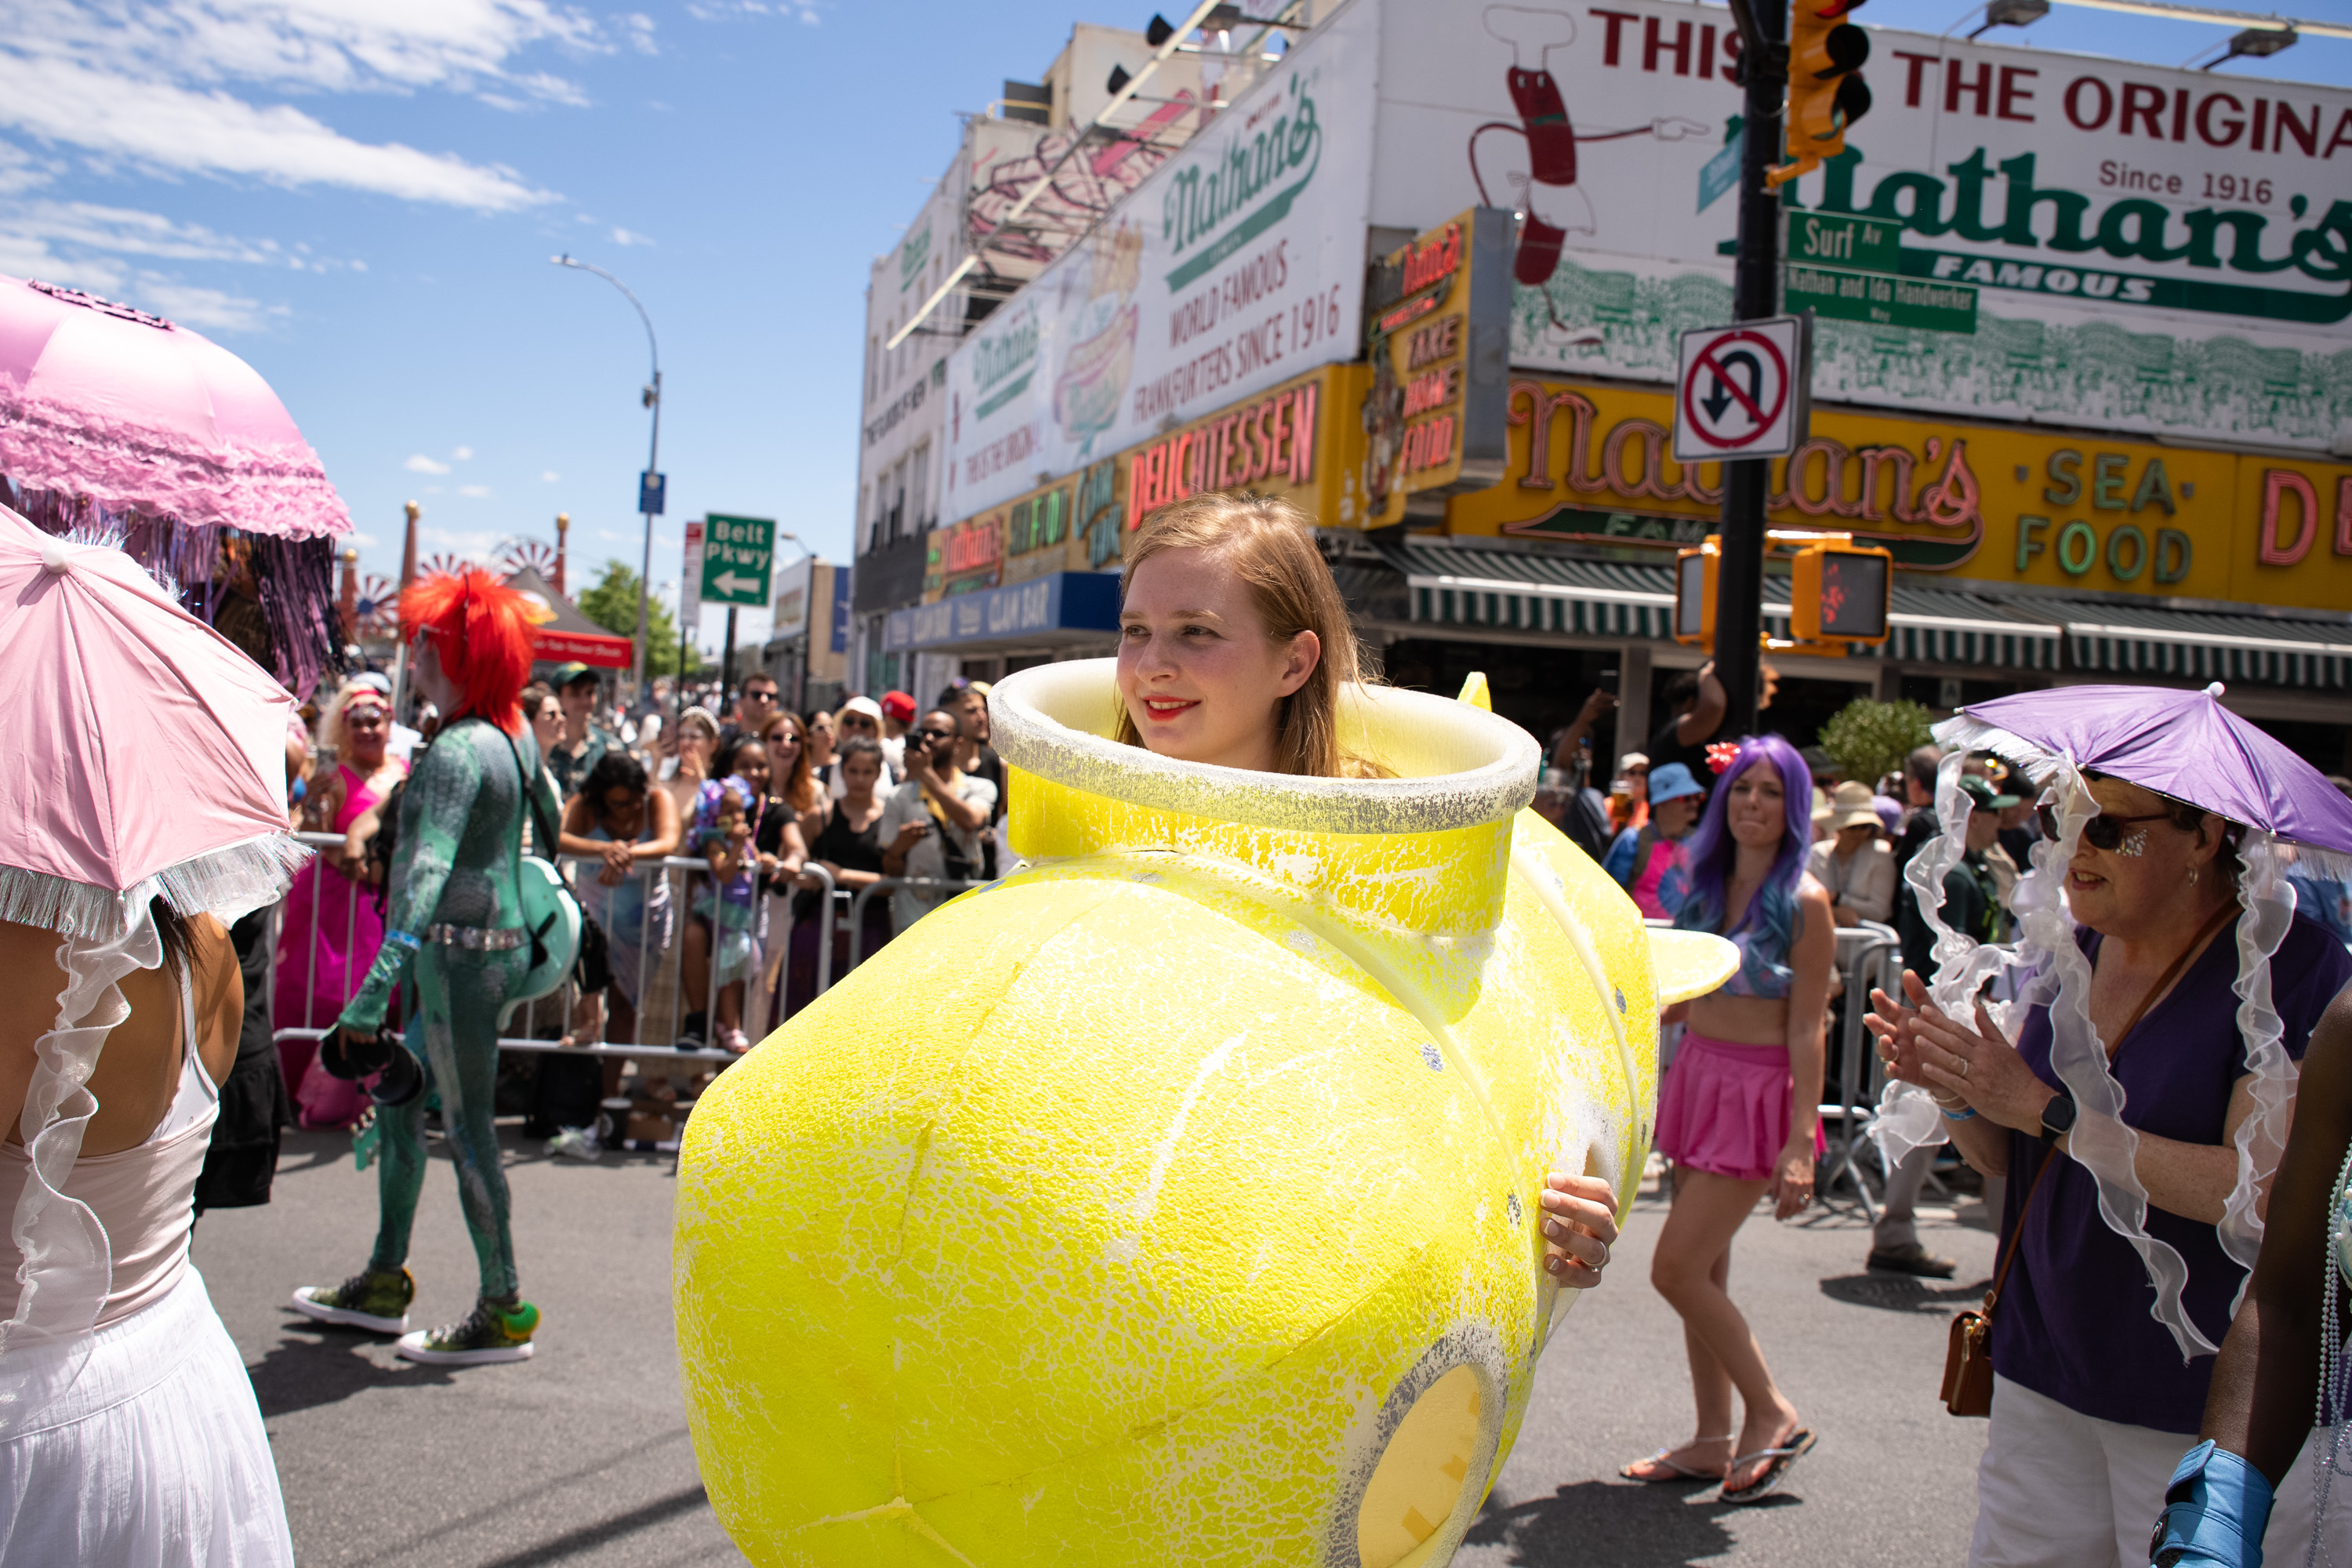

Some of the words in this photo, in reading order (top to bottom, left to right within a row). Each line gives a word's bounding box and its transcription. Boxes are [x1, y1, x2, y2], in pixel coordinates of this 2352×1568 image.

[1893, 50, 2040, 124] THE
[1163, 73, 1320, 255] Nathan's
[2100, 161, 2183, 194] Since
[2202, 172, 2273, 205] 1916
[1803, 218, 1854, 260] Surf
[1862, 223, 1882, 245] Av
[1170, 287, 1220, 349] WORLD
[1221, 239, 1288, 320] FAMOUS
[1788, 267, 1836, 296] Nathan
[1839, 276, 1865, 299] and
[1869, 277, 1891, 302] Ida
[1895, 279, 1974, 311] Handwerker
[1932, 256, 2158, 302] FAMOUS
[1236, 313, 1284, 379] SINCE
[1291, 283, 1341, 354] 1916
[1408, 314, 1459, 372] TAKE
[1127, 382, 1318, 532] DELICATESSEN
[1400, 416, 1454, 474] FOOD
[1508, 379, 1980, 528] Naan's
[2044, 449, 2176, 516] SEA
[706, 541, 770, 572] Pkwy
[714, 521, 765, 545] Belt
[2016, 515, 2193, 584] FOOD
